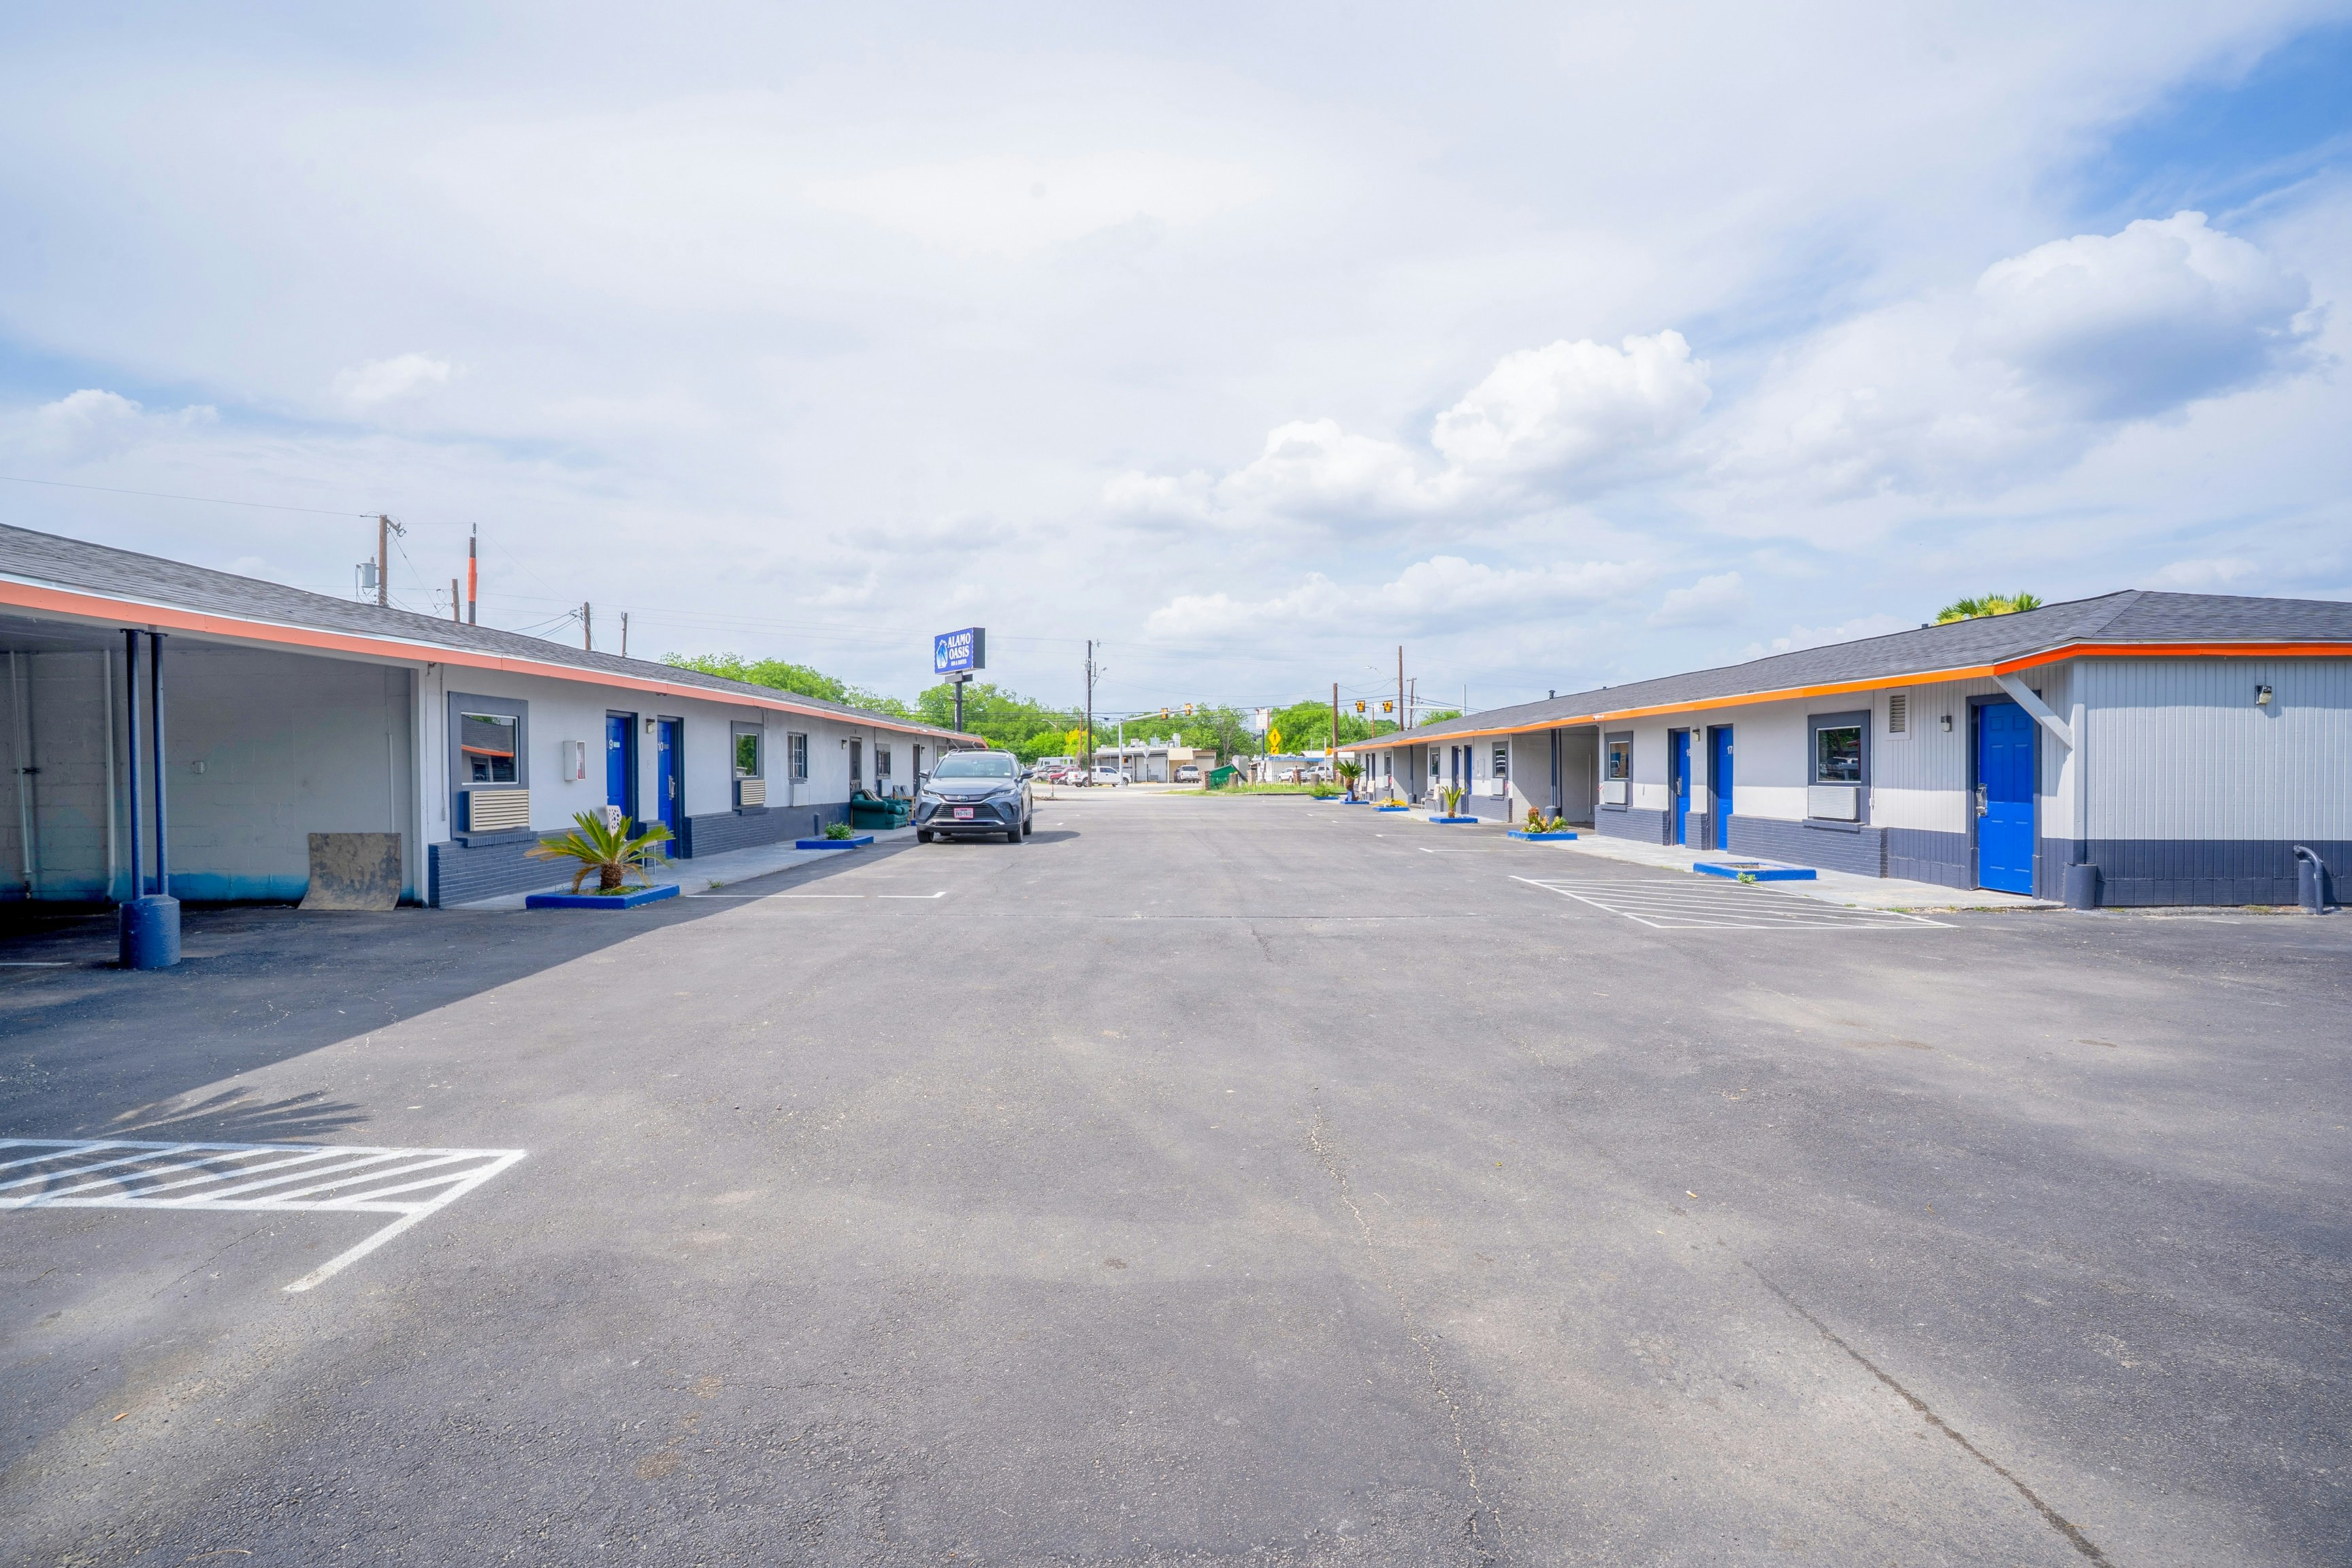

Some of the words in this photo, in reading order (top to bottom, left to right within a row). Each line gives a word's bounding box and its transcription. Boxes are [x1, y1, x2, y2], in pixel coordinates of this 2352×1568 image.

[947, 632, 971, 648] ALAMO
[949, 645, 970, 660] OASIS
[609, 739, 613, 749] 9
[657, 742, 664, 751] 10
[1727, 746, 1733, 755] 17
